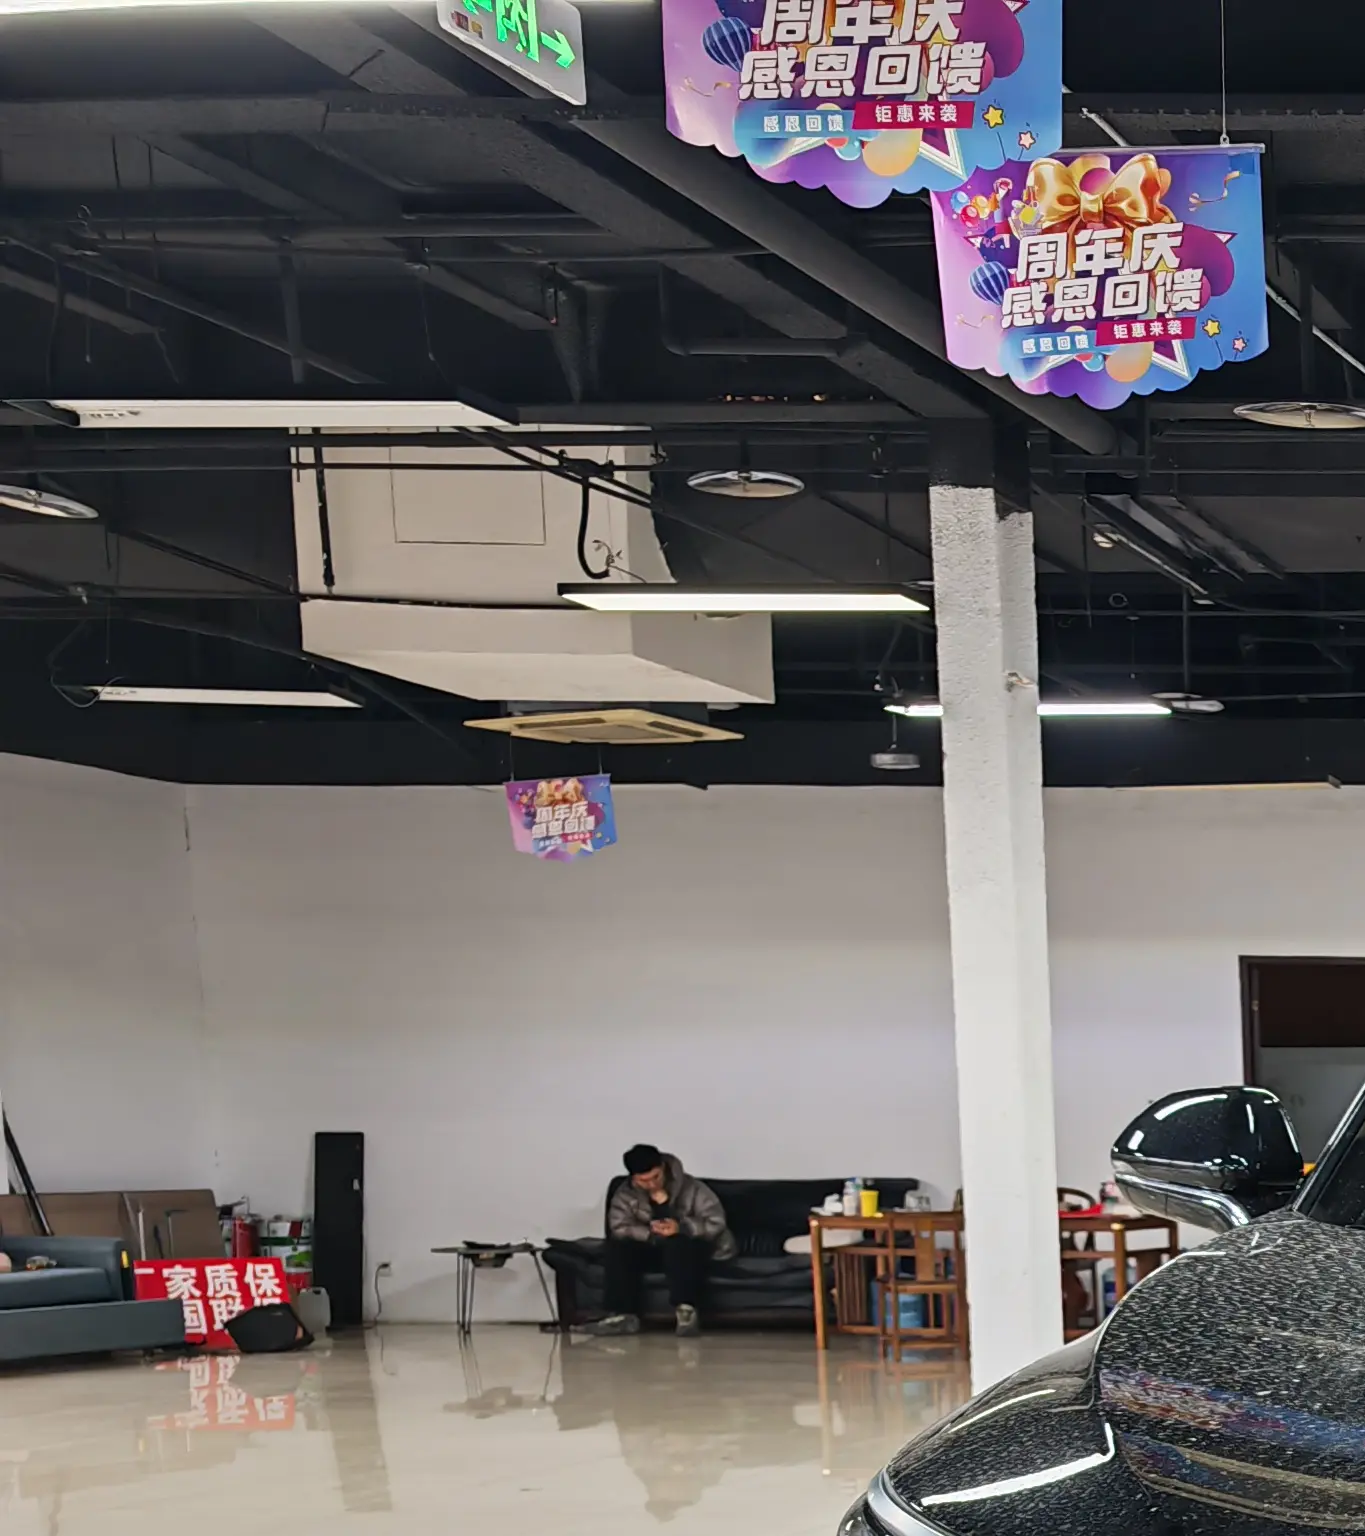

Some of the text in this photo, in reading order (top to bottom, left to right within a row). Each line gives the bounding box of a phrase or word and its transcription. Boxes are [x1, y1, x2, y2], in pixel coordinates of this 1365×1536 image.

[759, 0, 966, 46] 周年庆
[738, 41, 987, 100] 感恩回馈
[875, 103, 958, 123] 钜惠来袭
[1016, 221, 1184, 283] 周年庆
[1001, 268, 1203, 329] 感恩回馈
